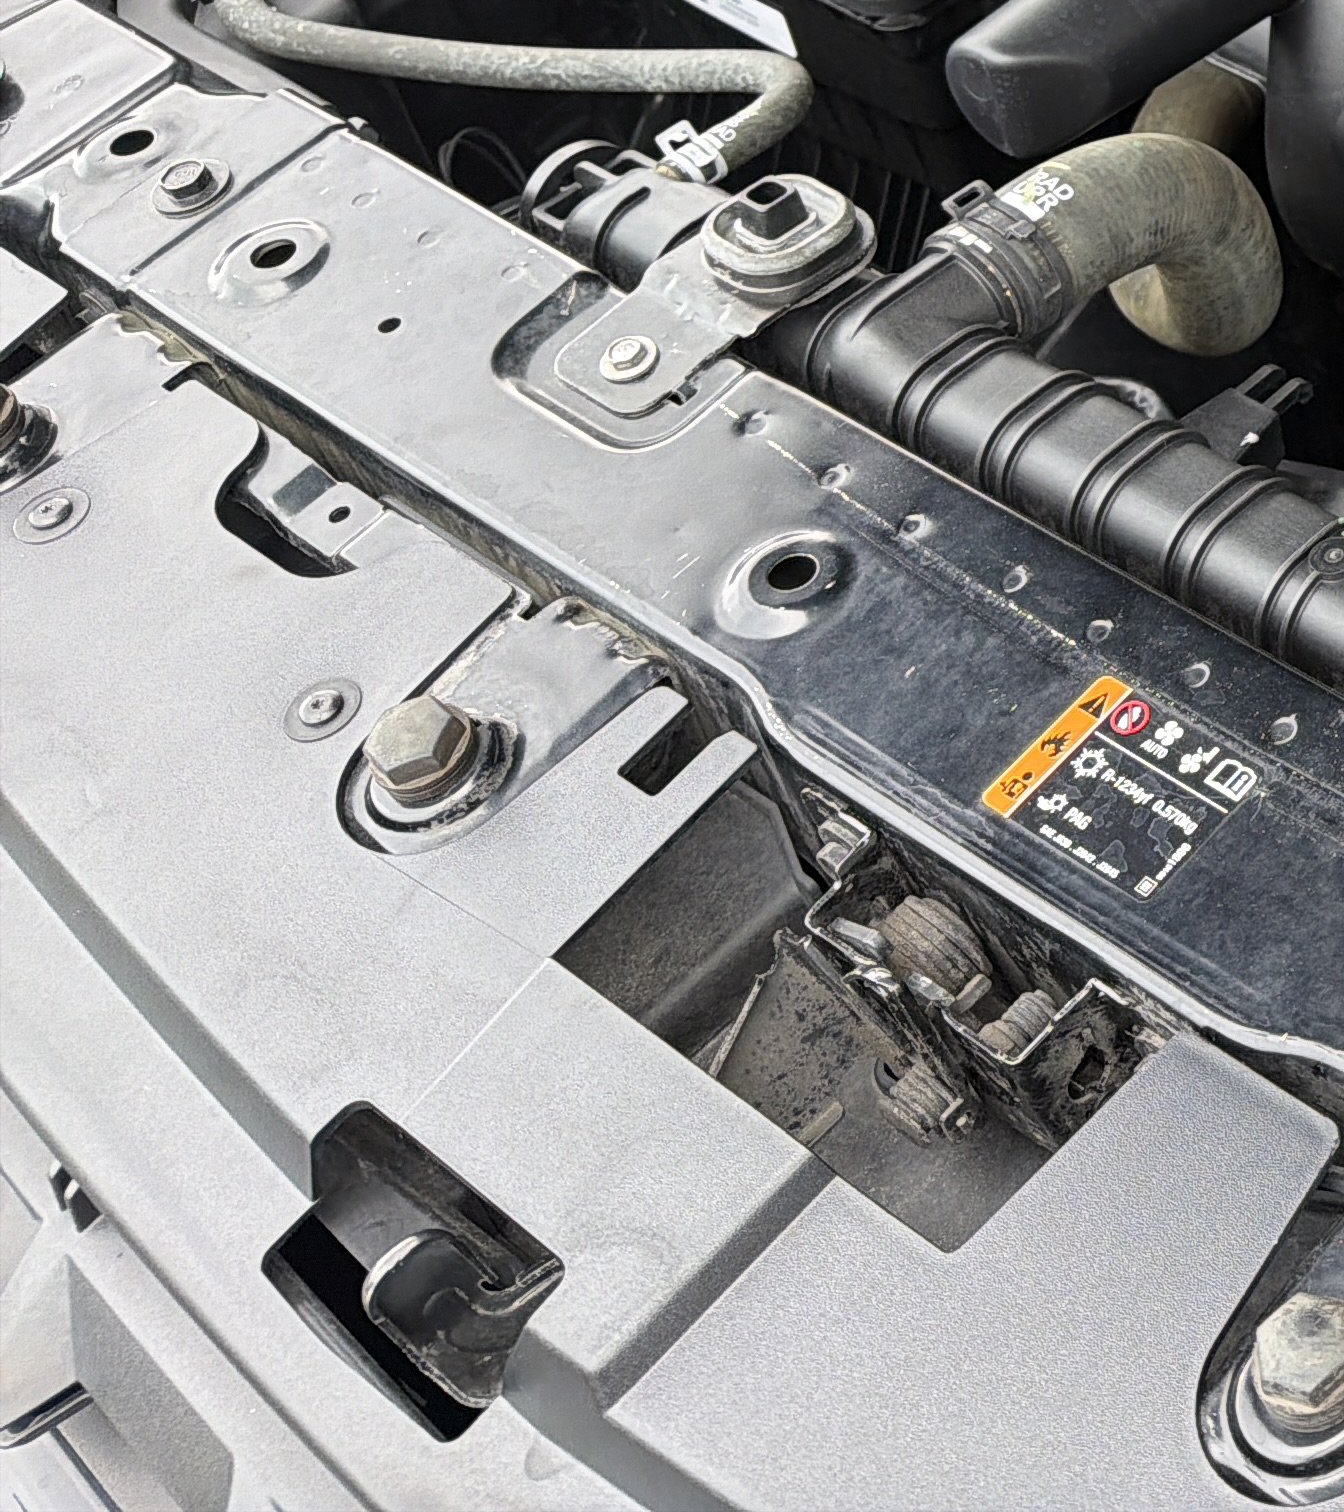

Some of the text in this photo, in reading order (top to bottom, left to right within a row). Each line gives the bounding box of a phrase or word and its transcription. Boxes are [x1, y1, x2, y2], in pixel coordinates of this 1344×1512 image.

[1026, 169, 1074, 202] RAD
[1139, 737, 1170, 761] AUTO
[1097, 765, 1201, 836] R-1234yf 0.570kg
[1061, 805, 1094, 831] PAG
